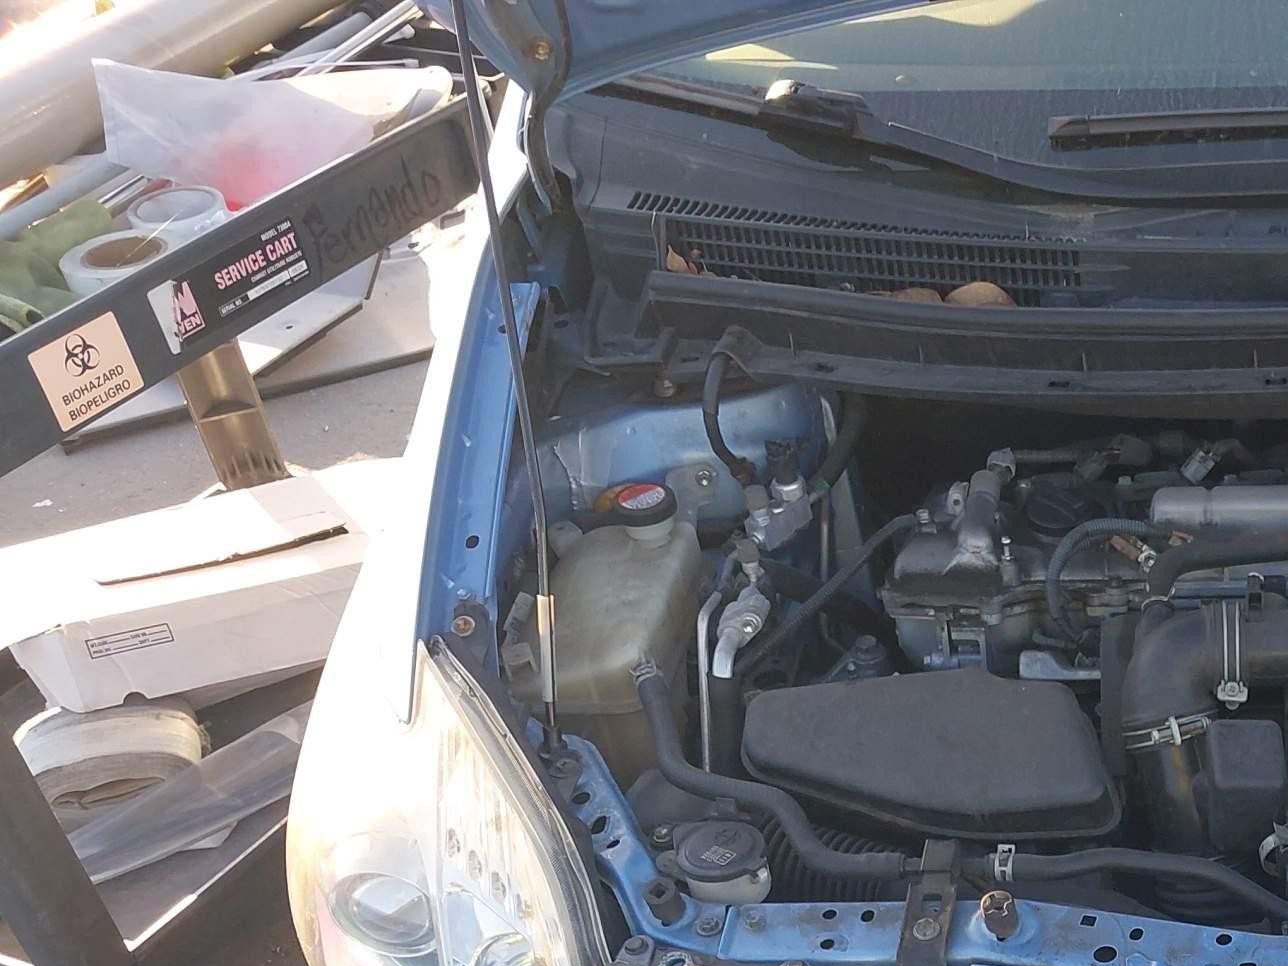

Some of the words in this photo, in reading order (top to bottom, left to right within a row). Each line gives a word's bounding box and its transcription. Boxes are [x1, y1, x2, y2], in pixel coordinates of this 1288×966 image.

[214, 249, 267, 290] SERVICE
[265, 232, 298, 262] CART
[62, 364, 124, 406] BIOHAZARD
[68, 379, 131, 421] BIOPELIGRO
